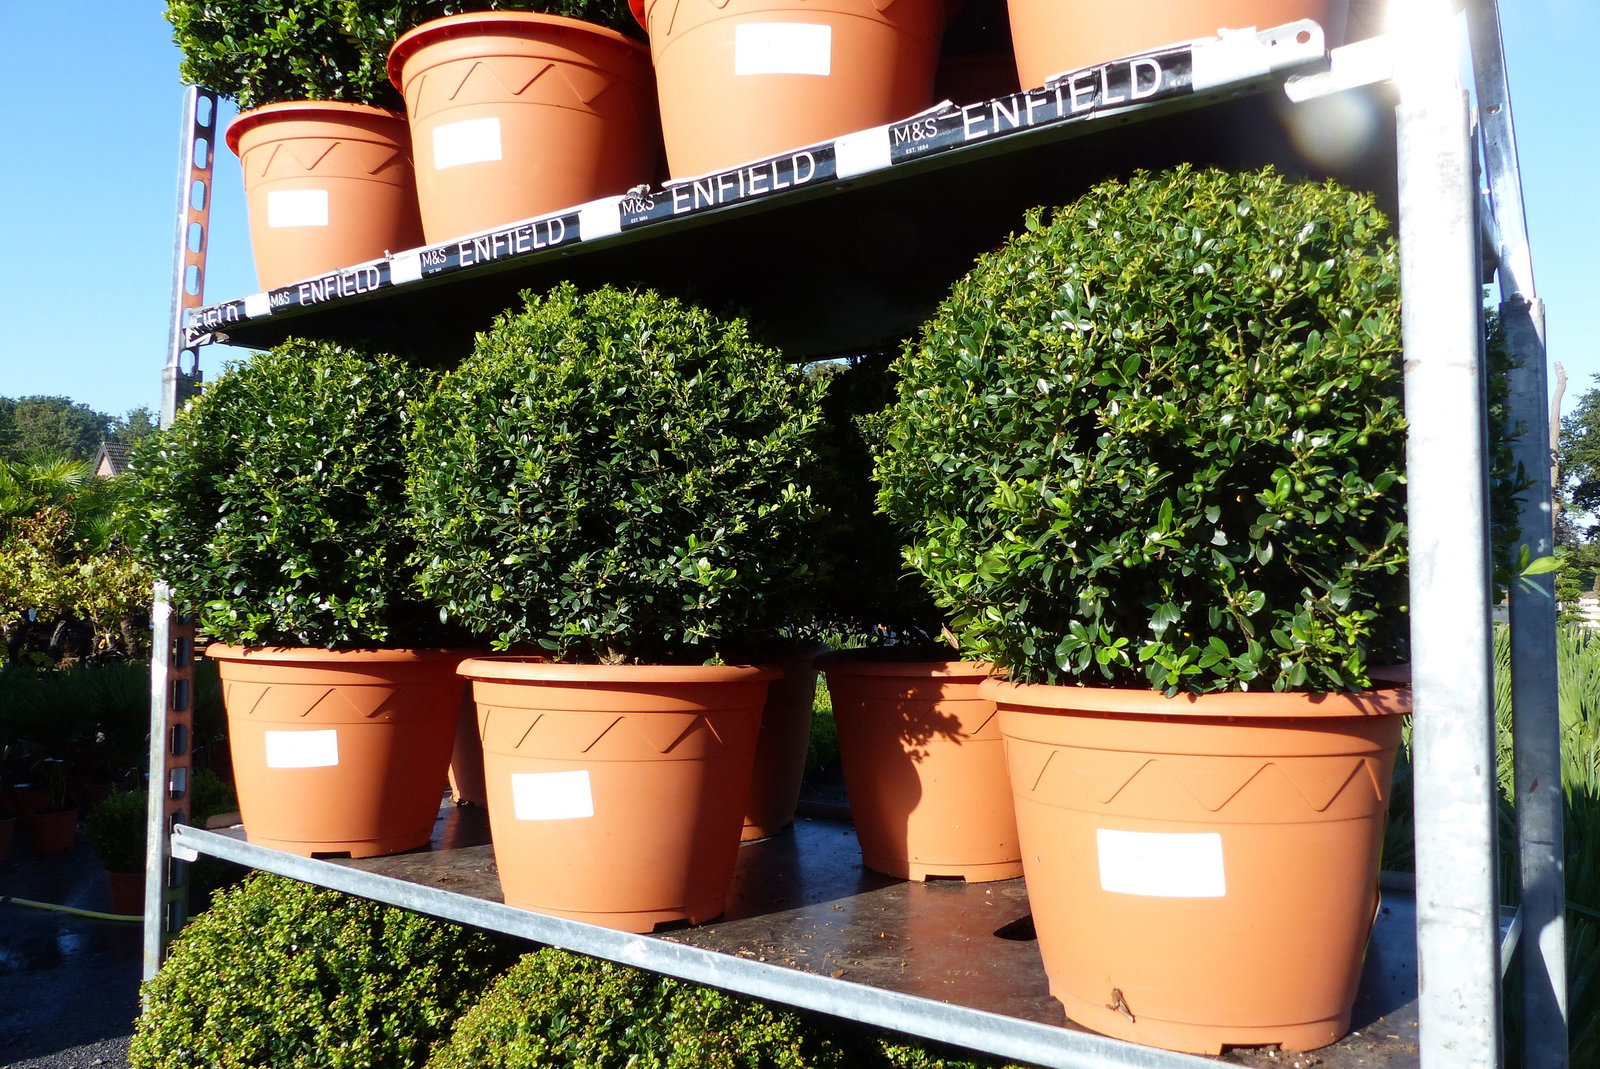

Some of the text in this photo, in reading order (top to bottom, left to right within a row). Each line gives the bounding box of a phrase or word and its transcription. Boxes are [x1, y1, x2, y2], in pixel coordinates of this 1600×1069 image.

[894, 59, 1163, 147] M&S ENFIELD
[622, 151, 816, 217] M&S ENFIELD
[422, 217, 566, 268] M&S ENFIELD
[270, 266, 380, 308] M&S ENFIELD
